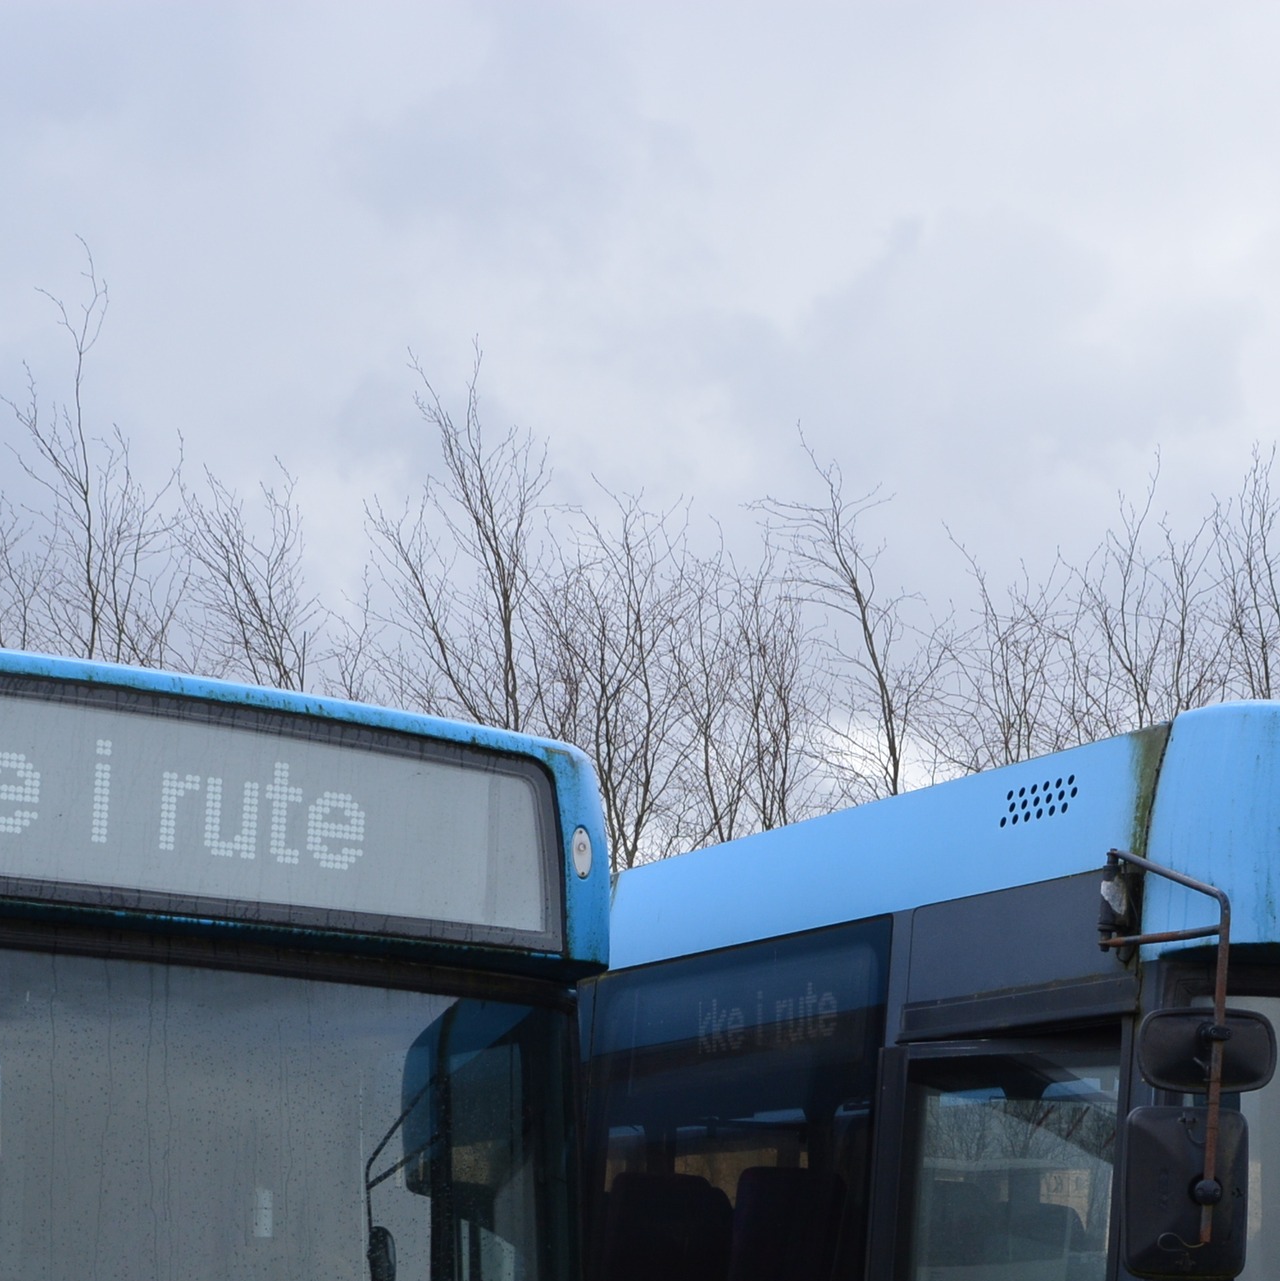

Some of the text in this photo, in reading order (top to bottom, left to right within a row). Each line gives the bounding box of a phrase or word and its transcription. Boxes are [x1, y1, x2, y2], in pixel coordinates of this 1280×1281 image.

[91, 739, 112, 843] i
[158, 762, 366, 871] rute
[776, 982, 837, 1043] rute
